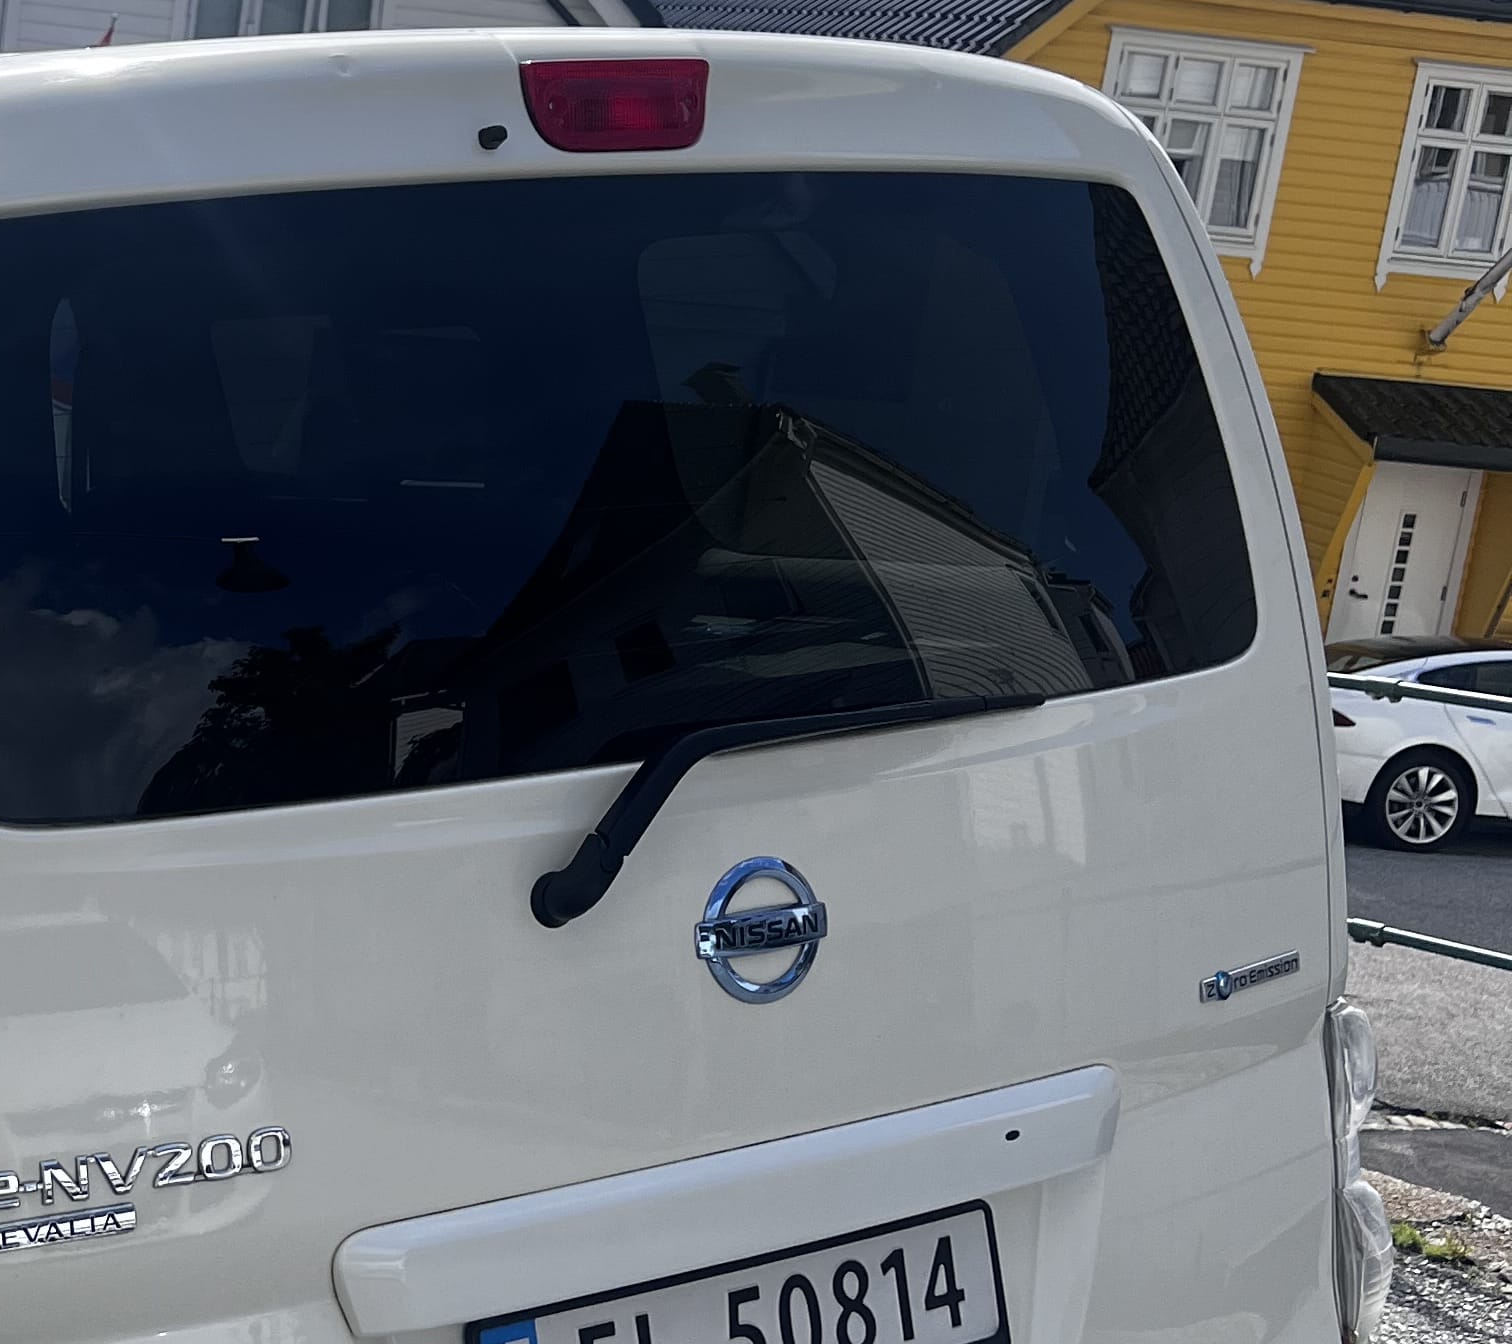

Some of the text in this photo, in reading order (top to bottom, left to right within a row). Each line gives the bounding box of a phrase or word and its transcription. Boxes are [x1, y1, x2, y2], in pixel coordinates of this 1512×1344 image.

[715, 912, 818, 949] NISSAN
[1206, 957, 1298, 1000] Zro Emission
[1, 1212, 122, 1248] EVALIA
